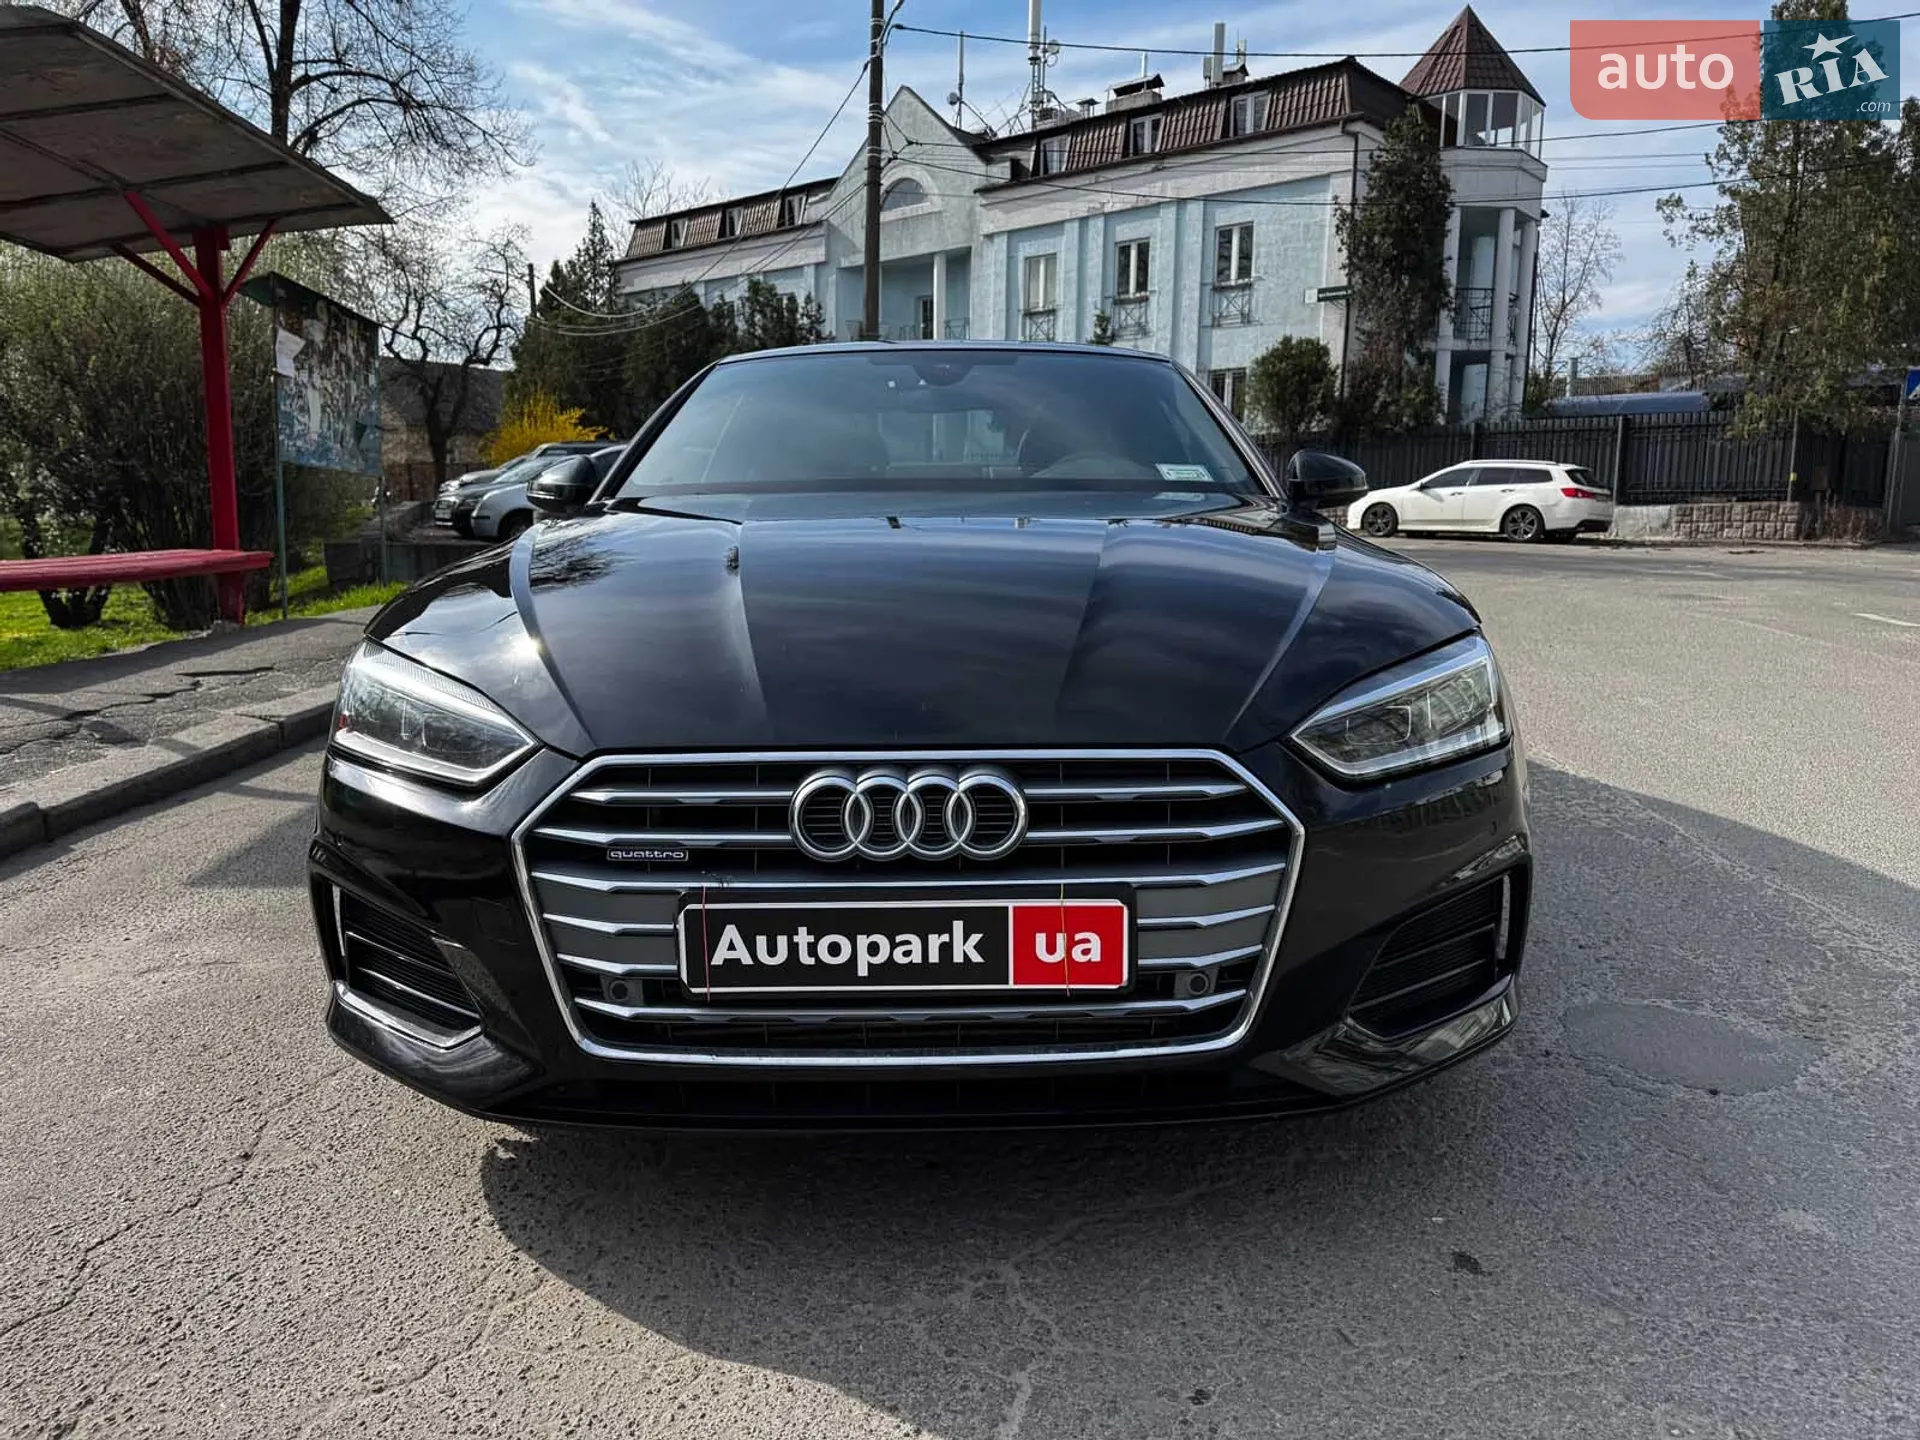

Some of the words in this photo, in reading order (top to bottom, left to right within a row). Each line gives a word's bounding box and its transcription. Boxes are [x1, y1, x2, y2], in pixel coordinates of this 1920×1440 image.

[610, 850, 684, 859] quattro
[710, 920, 985, 977] Autopark
[1035, 930, 1101, 963] ua
